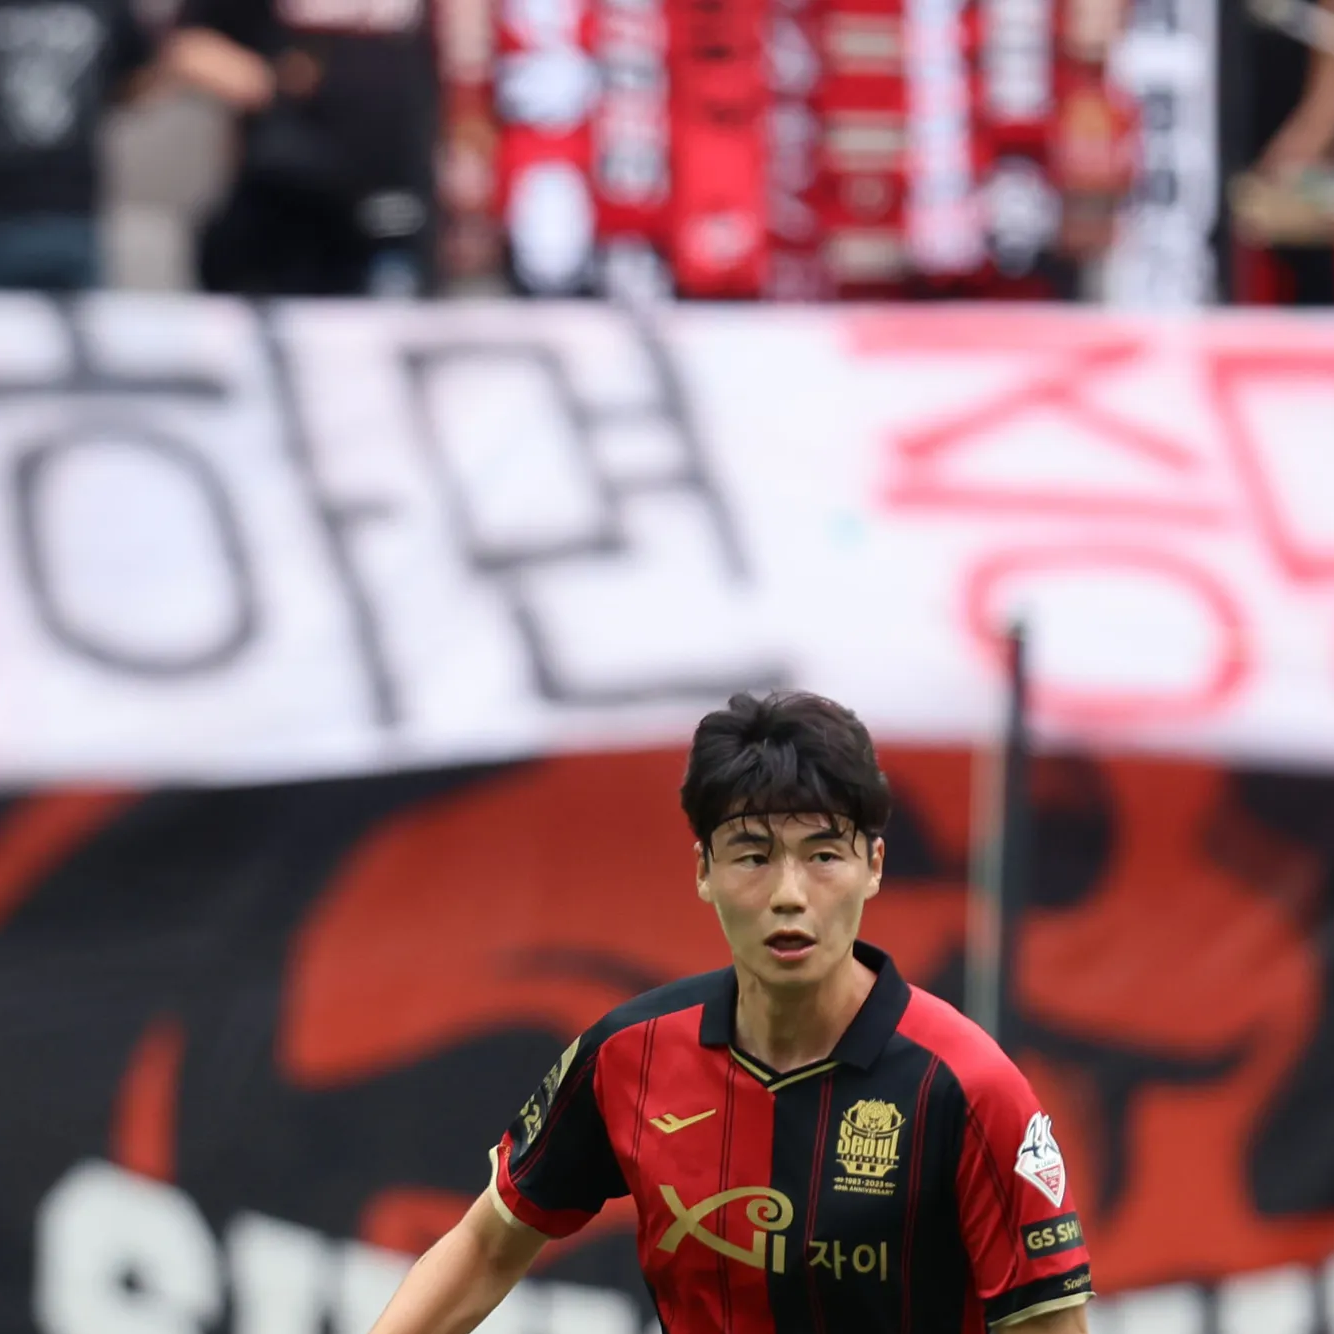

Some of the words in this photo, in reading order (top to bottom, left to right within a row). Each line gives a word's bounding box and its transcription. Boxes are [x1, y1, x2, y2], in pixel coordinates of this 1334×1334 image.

[837, 1119, 900, 1160] Seoul
[1027, 1227, 1056, 1250] GS
[809, 1239, 887, 1282] 자이
